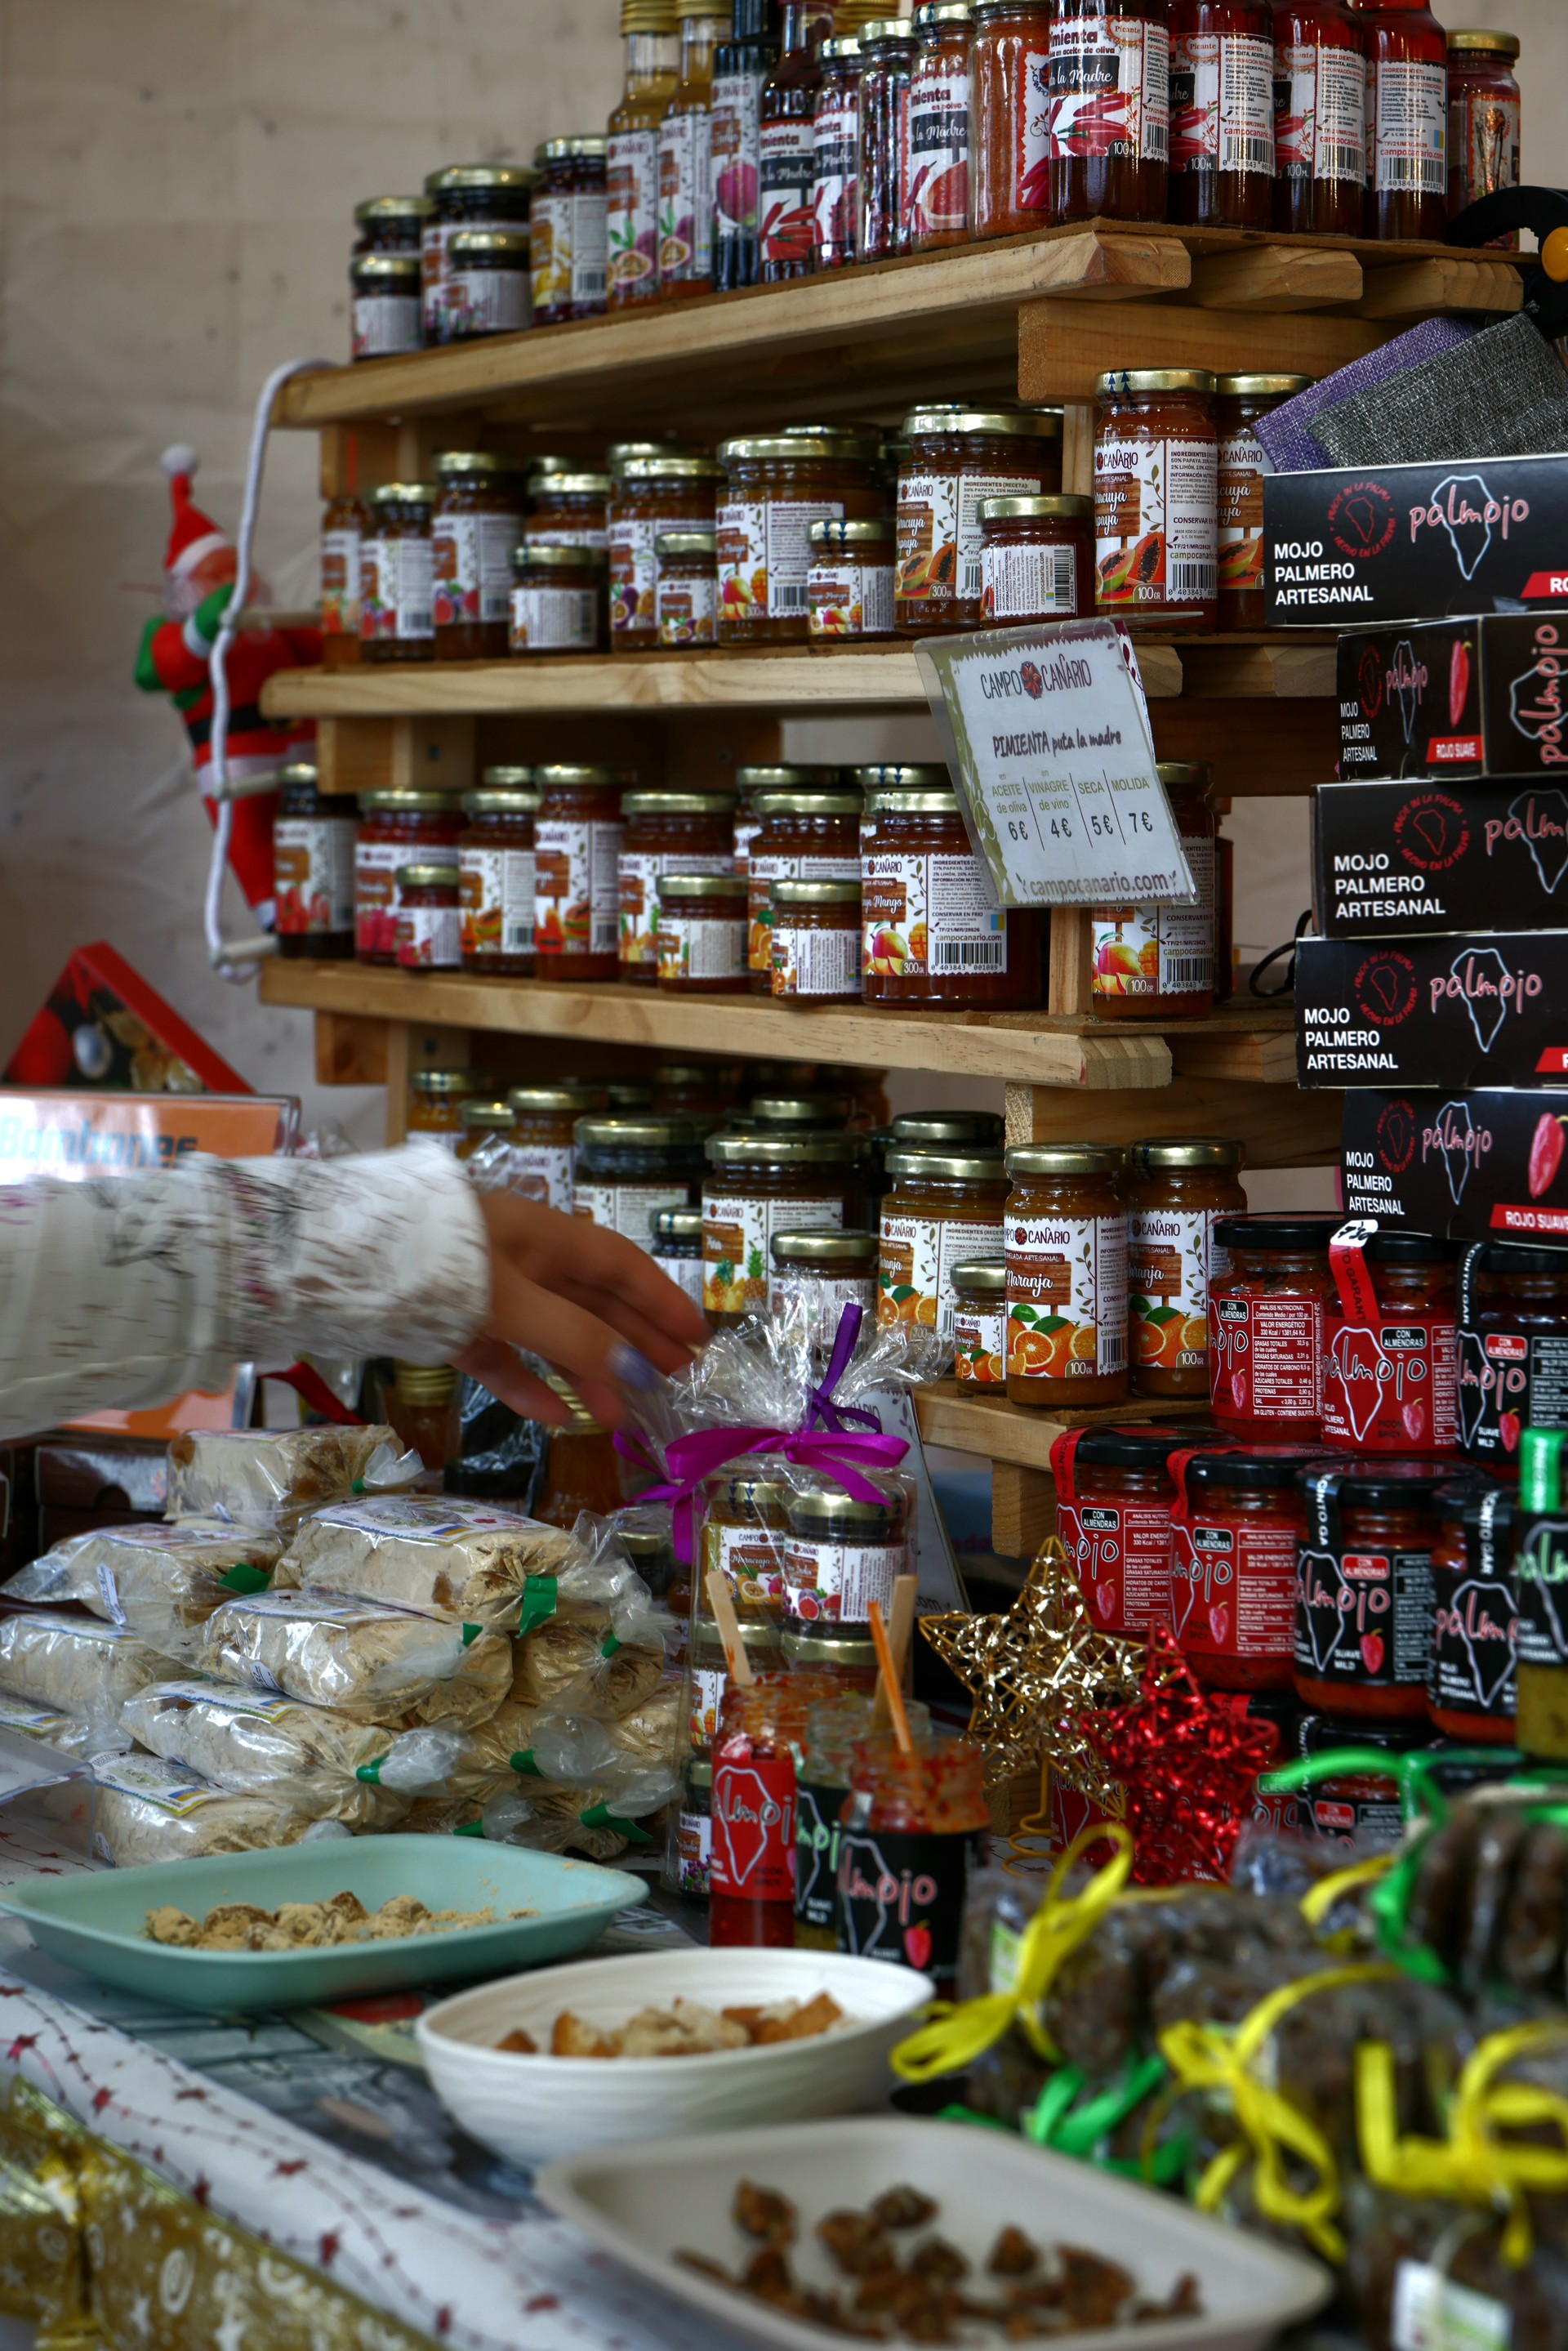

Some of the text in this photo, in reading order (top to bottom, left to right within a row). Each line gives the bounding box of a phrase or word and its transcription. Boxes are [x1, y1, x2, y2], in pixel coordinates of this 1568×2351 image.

[1115, 25, 1141, 34] Picante
[1096, 46, 1116, 54] oliva
[1058, 64, 1112, 84] la Madre
[911, 87, 951, 105] mienta
[760, 132, 800, 146] mienta
[926, 123, 966, 140] Madre
[1380, 148, 1444, 159] campocanario.com
[1103, 449, 1138, 470] CAÑARIO
[1223, 446, 1263, 463] CAÑARIO
[907, 481, 933, 497] CAÑARIO
[1409, 484, 1530, 543] palmojo
[898, 538, 919, 557] paya
[1274, 541, 1324, 560] MOJO
[1275, 563, 1355, 582] PALMERO
[1275, 586, 1374, 606] ARTESANAL
[980, 654, 1092, 699] CAMPO CAÑARIO
[1386, 649, 1428, 705] palmojo
[1340, 702, 1358, 718] MOJO
[1341, 723, 1370, 740] PALMERO
[993, 725, 1122, 758] PIMIENTA puta la madre
[1343, 745, 1378, 762] ARTESANAL
[1436, 744, 1455, 758] ROJO
[992, 785, 1022, 796] ACEITE
[1028, 779, 1070, 795] VINAGRE
[1078, 781, 1105, 795] SECA
[1111, 776, 1150, 792] MOLIDA
[996, 799, 1027, 814] de oliva
[1039, 798, 1070, 811] de vino
[1484, 797, 1568, 856] palm
[875, 859, 902, 873] CAÑARIO
[1334, 854, 1389, 872] MOJO
[1030, 871, 1169, 898] campocanario.com
[1335, 876, 1425, 895] PALMERO
[874, 894, 903, 914] Mango
[1335, 898, 1446, 918] ARTESANAL
[936, 934, 1002, 943] campocanario.com
[1430, 957, 1543, 1014] palmojo
[1304, 1007, 1350, 1024] MOJO
[1305, 1030, 1380, 1046] PALMERO
[1307, 1053, 1399, 1070] ARTESANAL
[1422, 1109, 1493, 1169] palmojo
[1346, 1151, 1374, 1168] MOJO
[1347, 1174, 1392, 1192] PALMERO
[1349, 1196, 1405, 1216] ARTESANAL
[1142, 1219, 1180, 1236] CAÑARIO
[1505, 1211, 1535, 1228] ROJO
[890, 1221, 916, 1238] CAÑARIO
[1028, 1227, 1070, 1245] CAÑARIO
[1006, 1270, 1054, 1297] Naranja
[1347, 1267, 1366, 1321] GARANT
[1221, 1310, 1246, 1319] ALMENDRAS
[1227, 1302, 1237, 1310] CON
[1396, 1330, 1410, 1338] CON
[1499, 1337, 1512, 1347] CON
[1384, 1339, 1423, 1347] ALMENDRAS
[1458, 1340, 1526, 1411] lmojo
[1477, 1427, 1500, 1438] SUAVE
[1477, 1439, 1494, 1448] MILD
[1083, 1519, 1116, 1528] ALMENDRAS
[1093, 1511, 1105, 1519] CON
[738, 1533, 759, 1541] CAMPO
[1196, 1538, 1231, 1549] ALMENDRAS
[1205, 1530, 1219, 1540] CON
[1062, 1531, 1119, 1580] mojo
[1437, 1590, 1518, 1651] palm
[1334, 1661, 1356, 1671] MILD
[840, 1845, 938, 1925] lmojo
